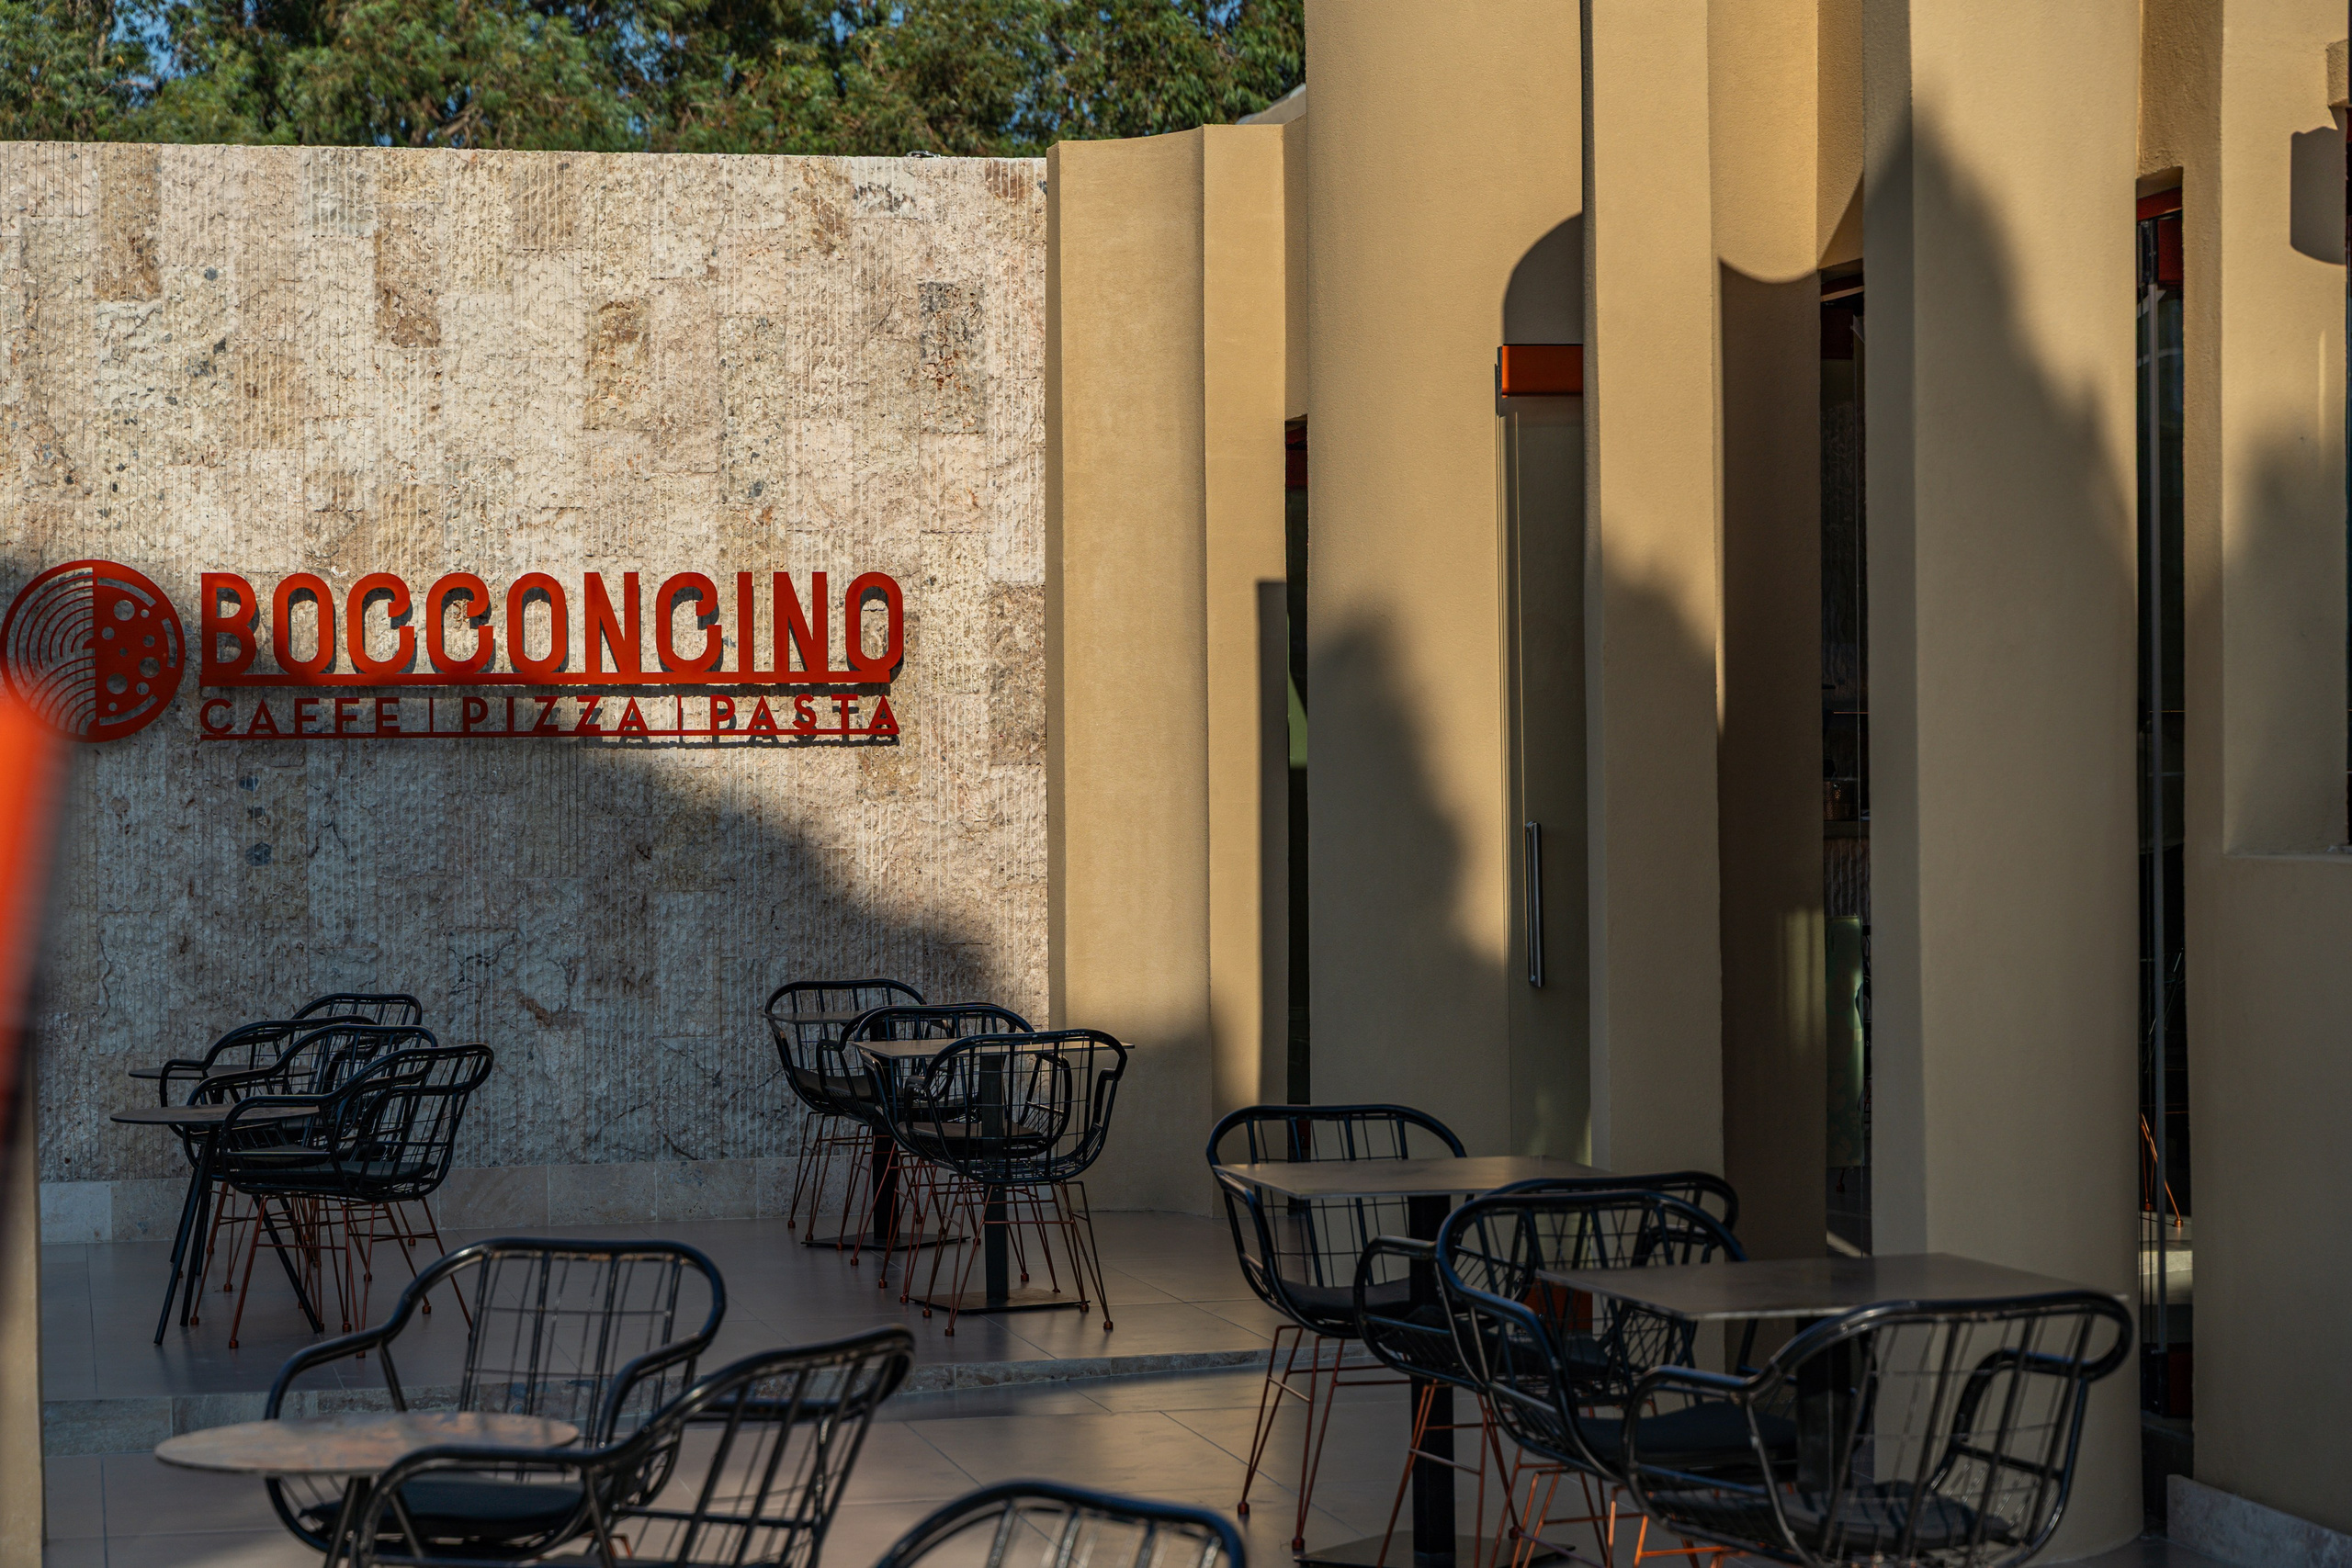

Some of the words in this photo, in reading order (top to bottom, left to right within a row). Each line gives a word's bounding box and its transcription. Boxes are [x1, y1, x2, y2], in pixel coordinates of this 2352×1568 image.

[201, 571, 903, 675] BOCCONCINO
[200, 697, 401, 734] CAFFE
[462, 695, 648, 733] PIZZA
[710, 694, 899, 733] PASTA
